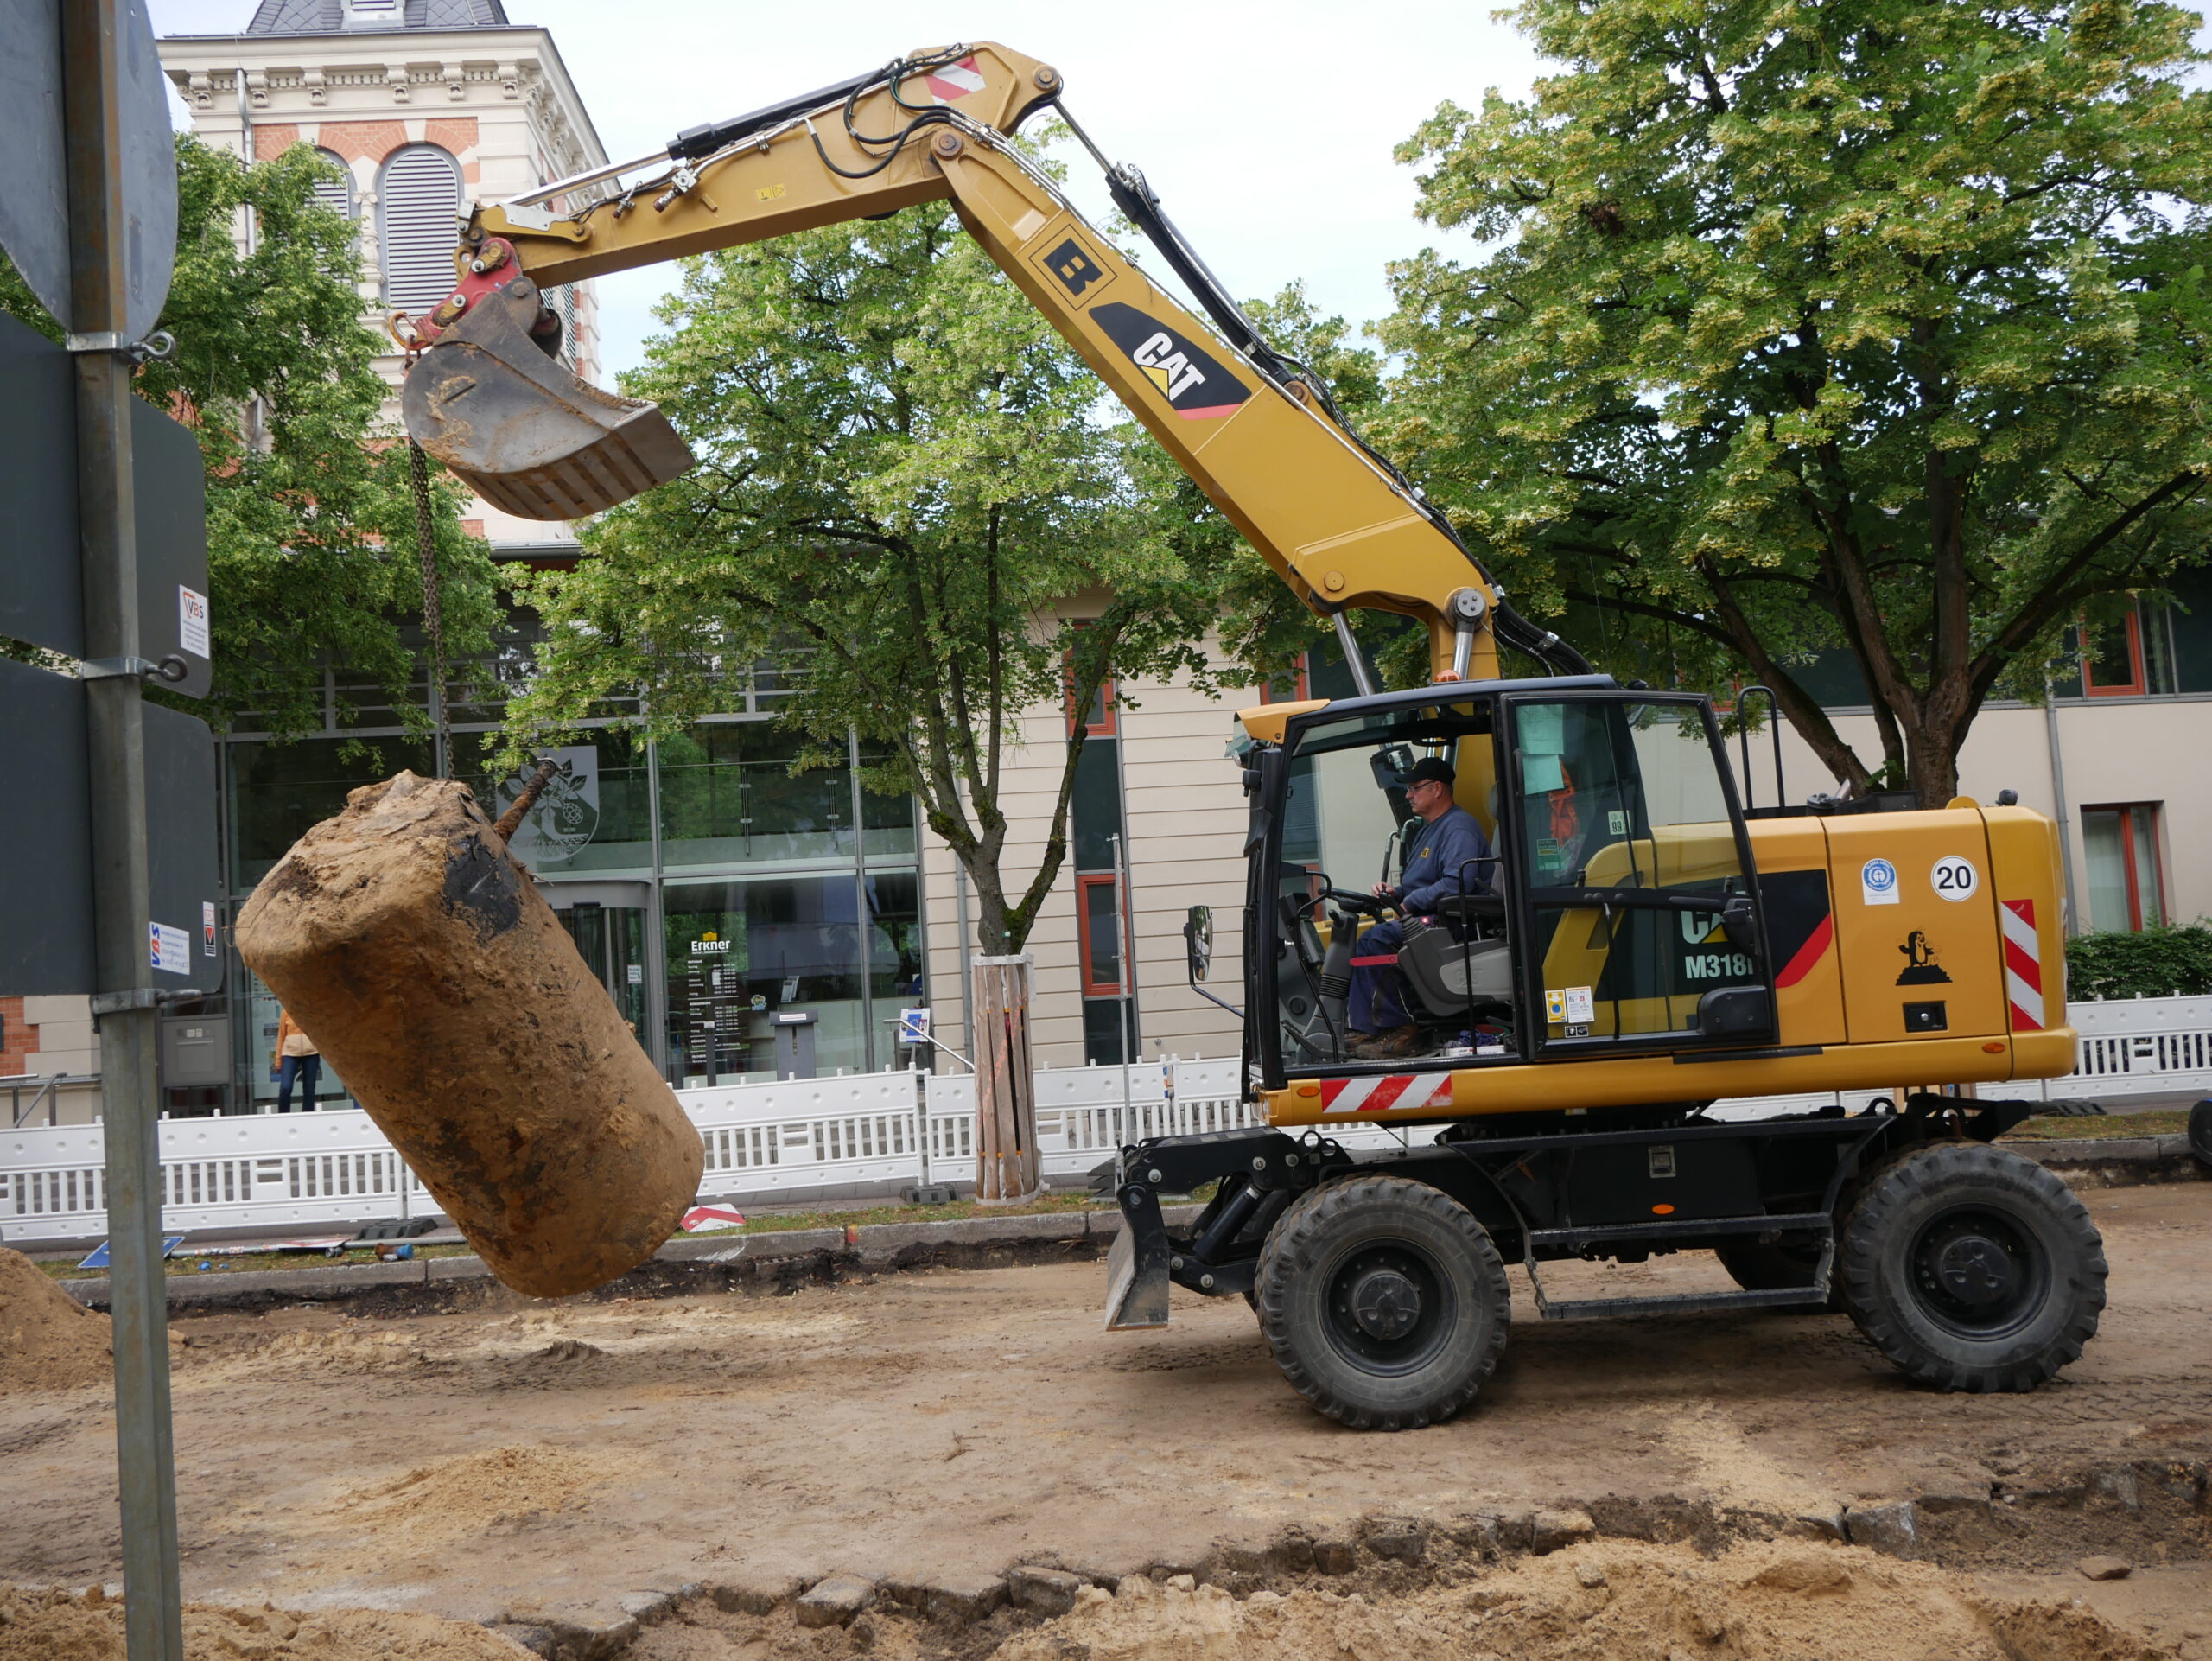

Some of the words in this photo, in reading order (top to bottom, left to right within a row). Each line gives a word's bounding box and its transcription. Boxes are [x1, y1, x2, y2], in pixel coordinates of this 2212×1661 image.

[1133, 331, 1206, 401] CAT
[188, 598, 204, 619] VBS
[1611, 820, 1623, 833] 99
[1936, 865, 1972, 890] 20
[690, 939, 731, 951] Erkner
